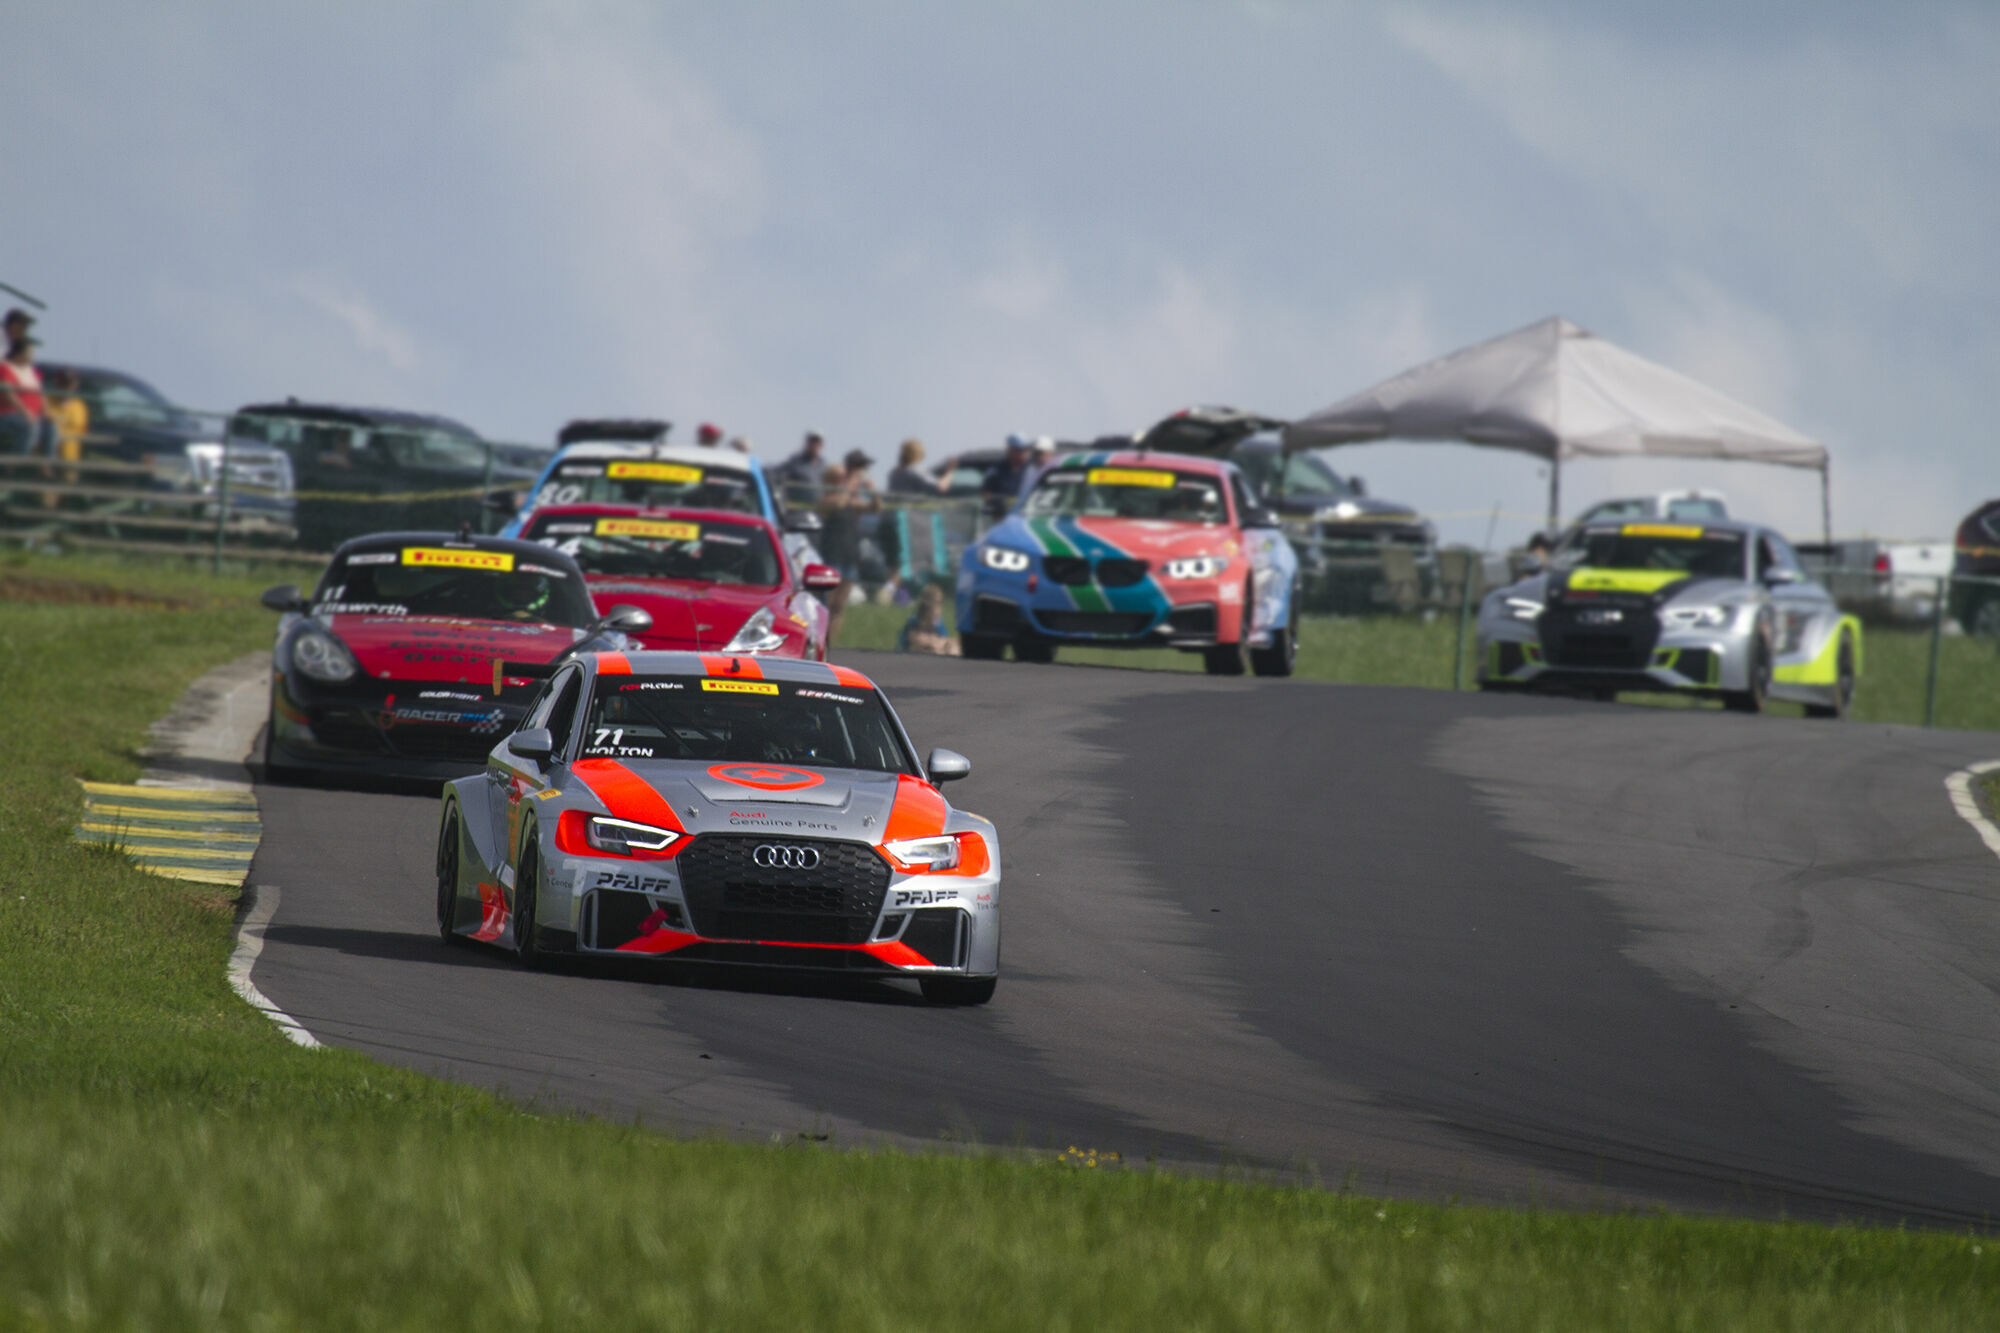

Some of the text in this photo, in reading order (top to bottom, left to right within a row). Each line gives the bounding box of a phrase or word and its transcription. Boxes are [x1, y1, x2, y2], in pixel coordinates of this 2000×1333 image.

[708, 682, 772, 693] PIRELLI
[594, 727, 624, 746] 71
[585, 746, 654, 757] HOLTON
[729, 810, 766, 819] Audi
[729, 818, 838, 831] Genuine Parts
[596, 872, 670, 892] PFAFF
[895, 889, 958, 906] PFAFF
